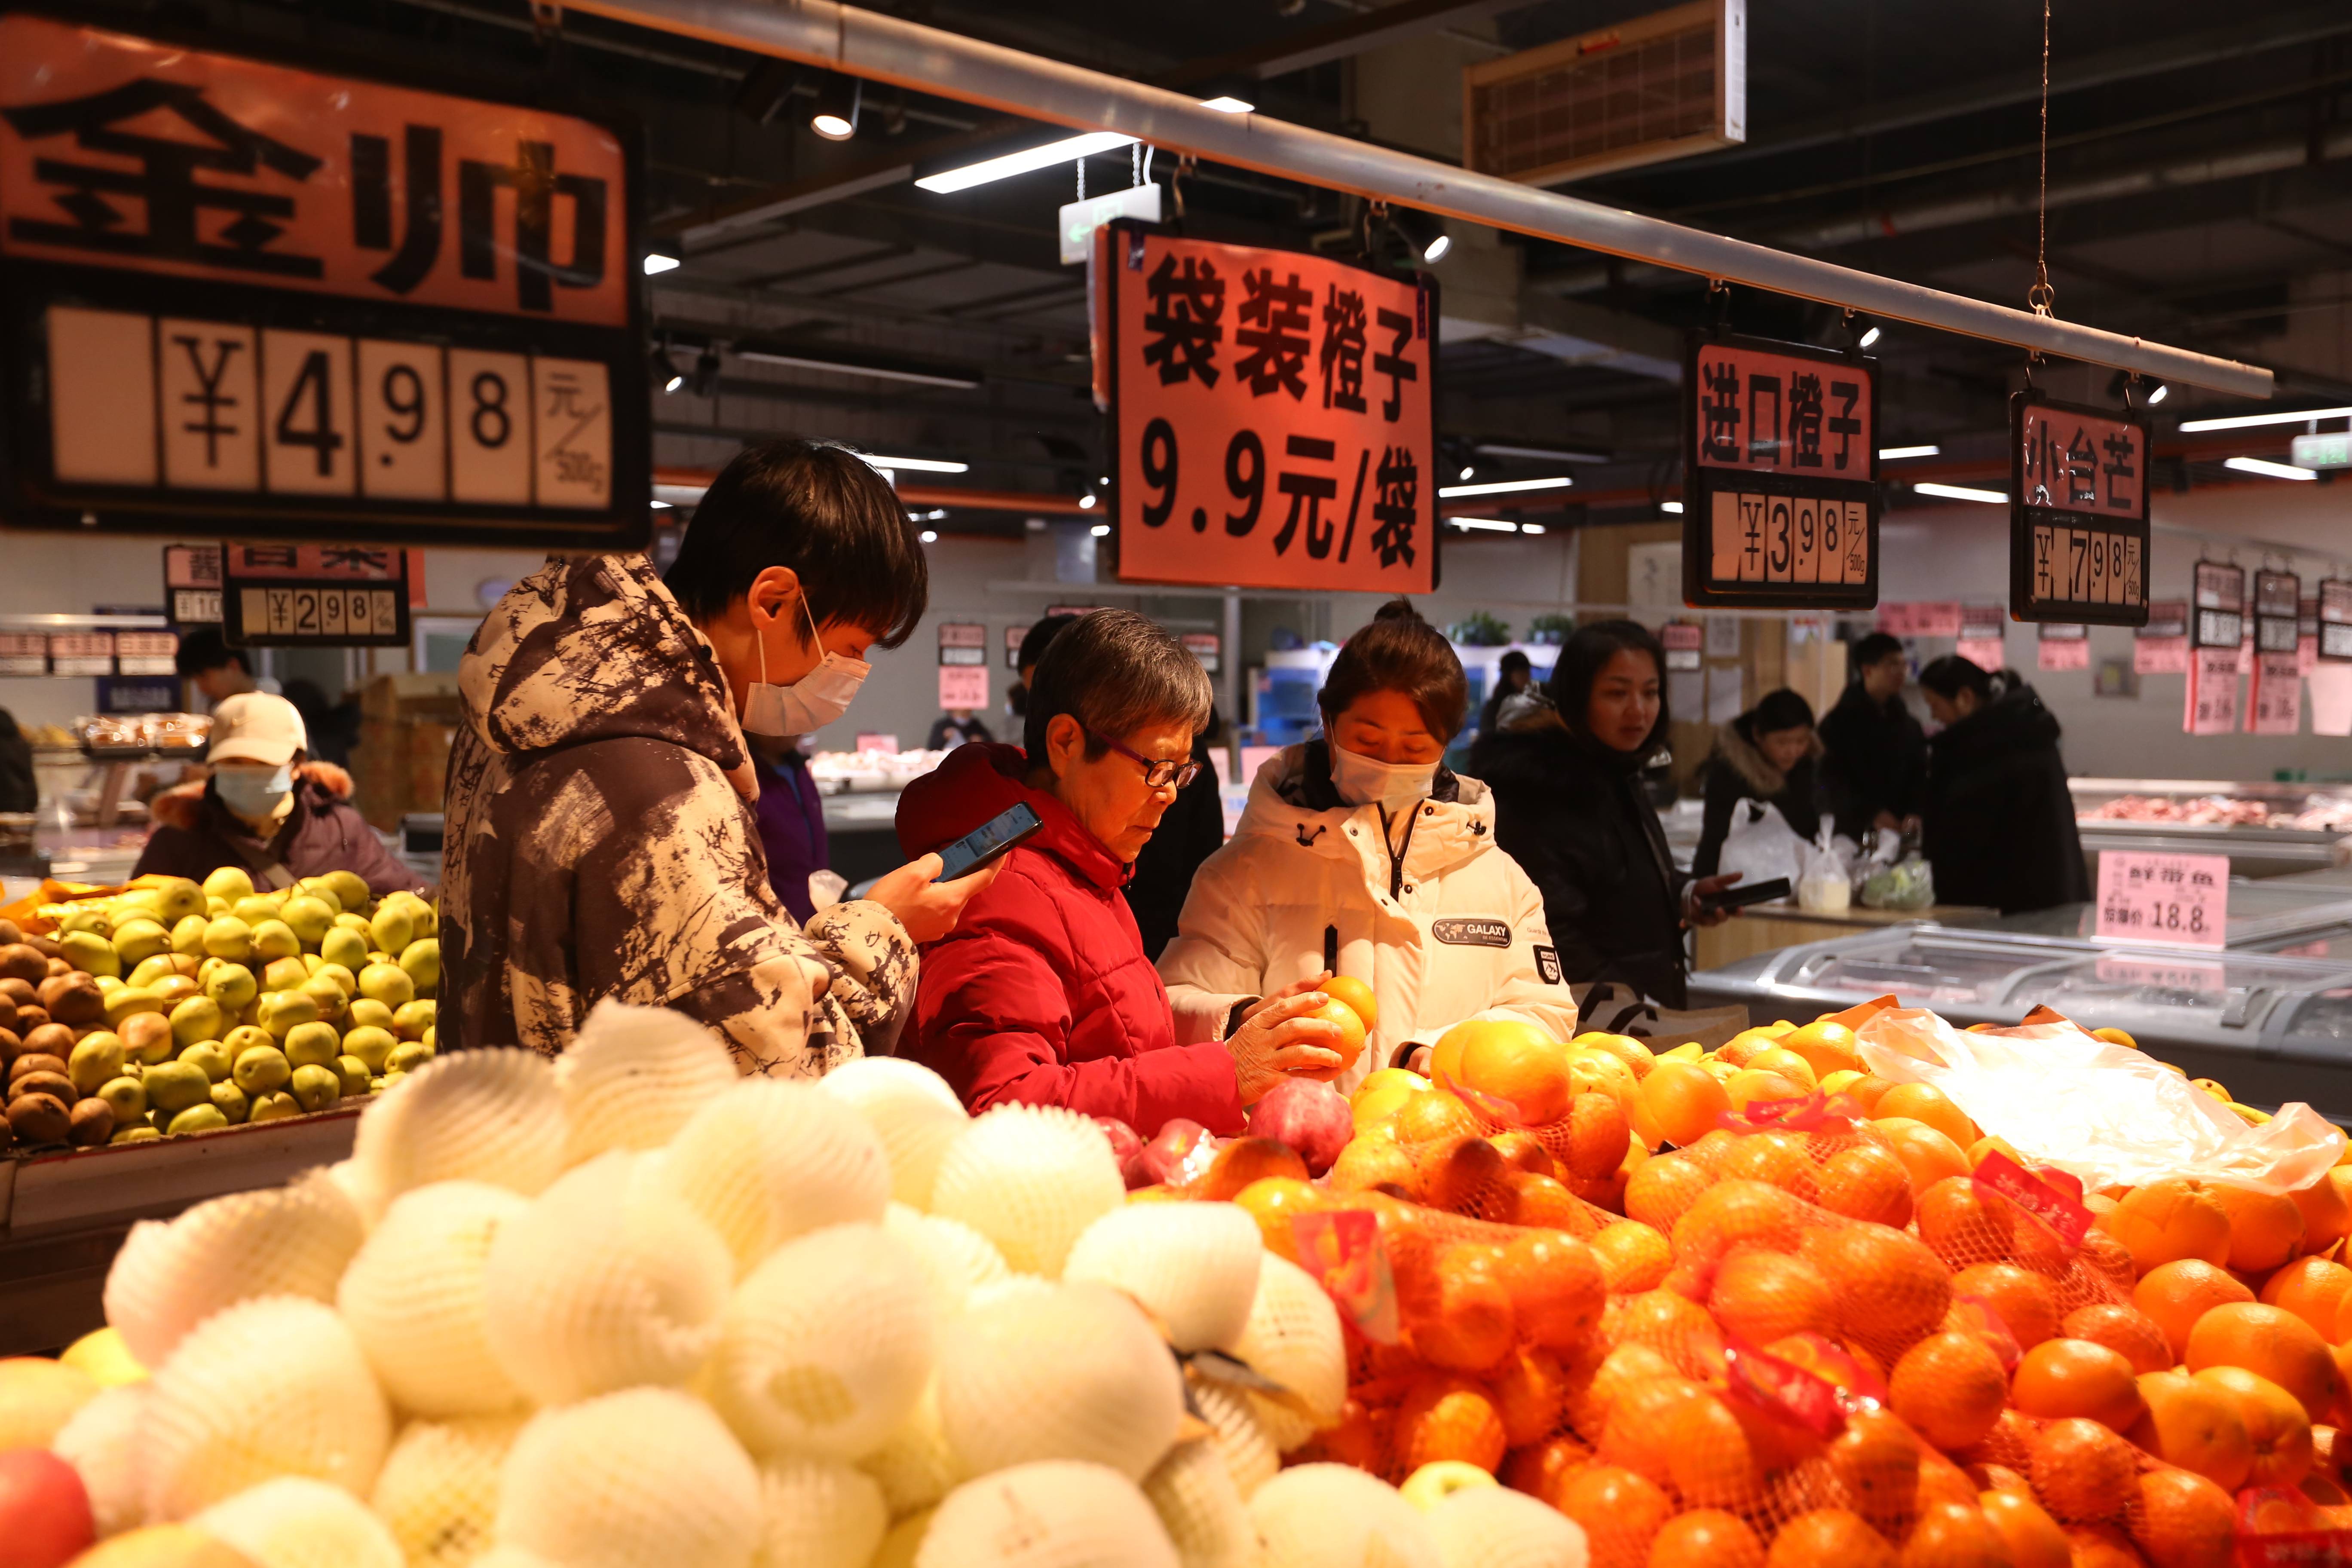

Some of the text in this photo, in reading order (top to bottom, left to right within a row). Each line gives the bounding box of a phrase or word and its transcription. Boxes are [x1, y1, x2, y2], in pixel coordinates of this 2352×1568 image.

[2, 77, 608, 313] 金帅
[1142, 252, 1418, 423] 袋装橙子
[1701, 362, 1862, 470] 进口橙子
[2025, 420, 2135, 510] 小台芒
[1141, 417, 1418, 570] 9.9元/袋
[1467, 924, 1506, 936] GALAXY
[2152, 901, 2203, 933] 18.8
